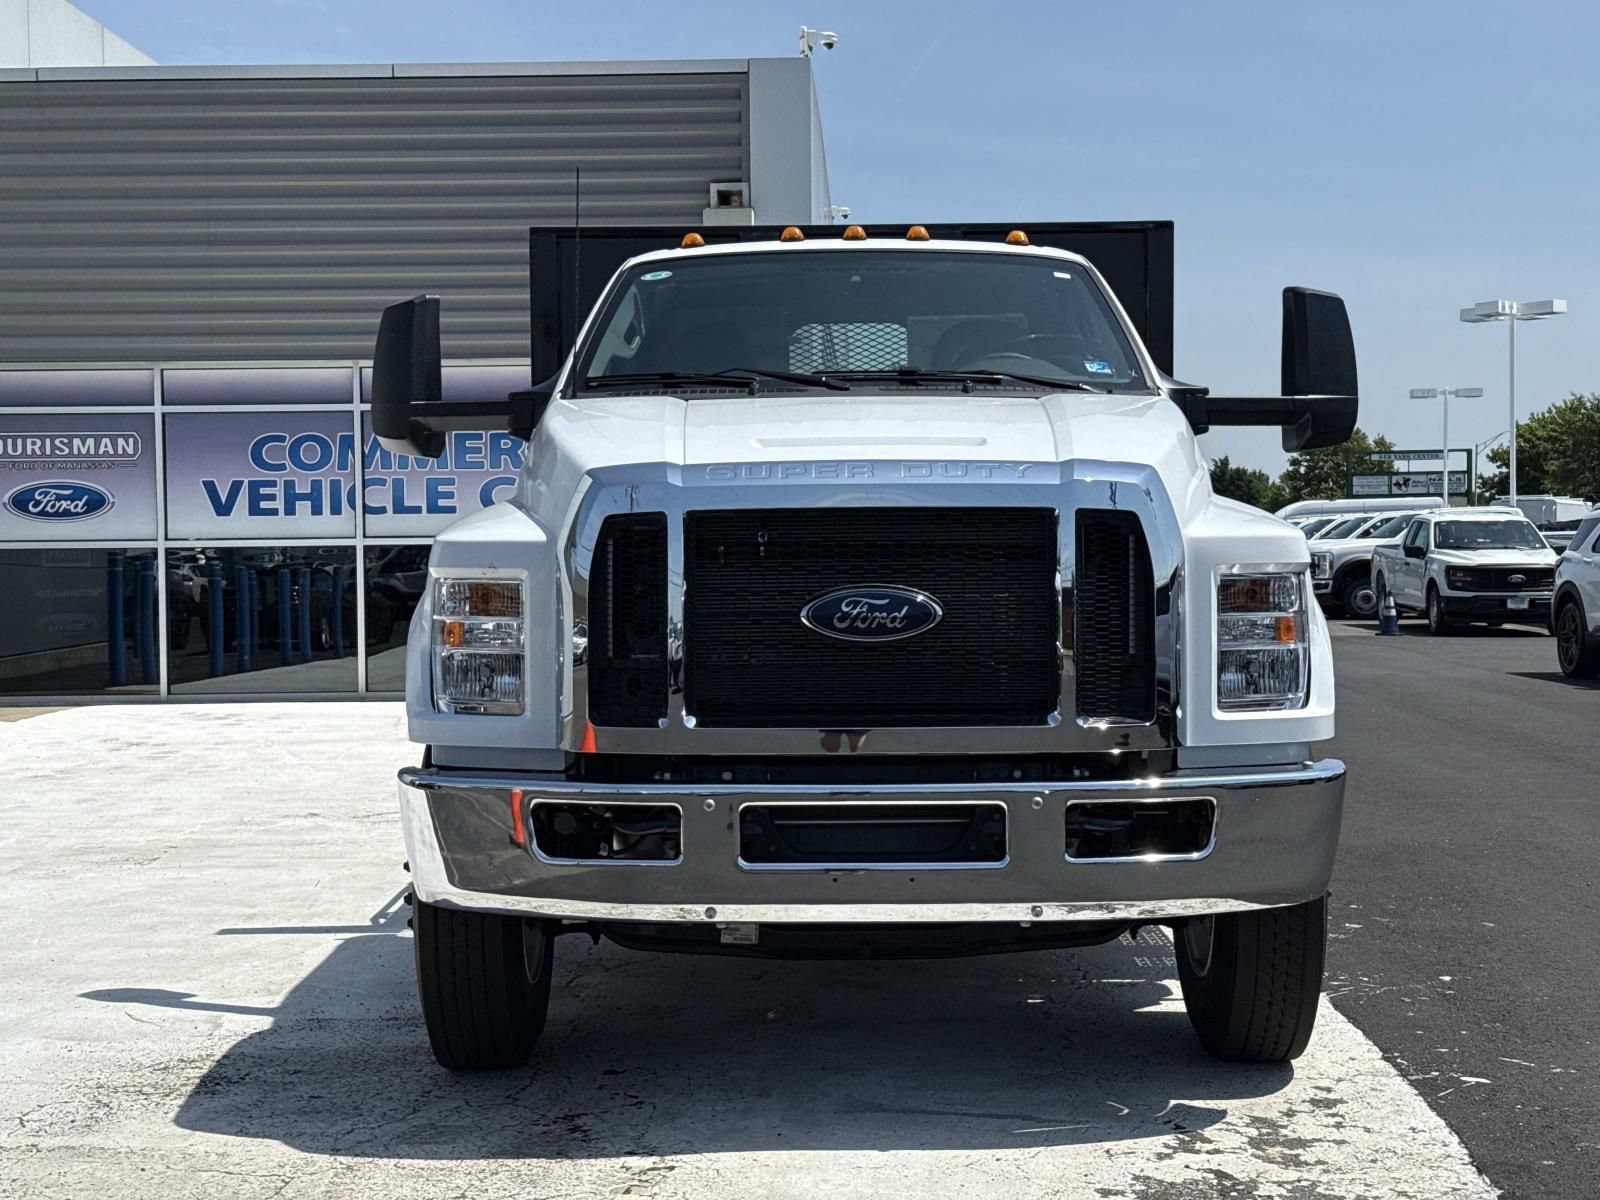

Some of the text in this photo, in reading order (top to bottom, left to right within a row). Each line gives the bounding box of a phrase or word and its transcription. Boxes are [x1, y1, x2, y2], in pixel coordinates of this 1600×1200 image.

[0, 437, 135, 455] URISMAN
[8, 461, 115, 471] FORD OF MANASSAS
[706, 462, 1033, 480] SUPER DUTY
[28, 488, 88, 514] Ford
[201, 476, 458, 517] VEHICLE
[833, 597, 909, 629] Ford
